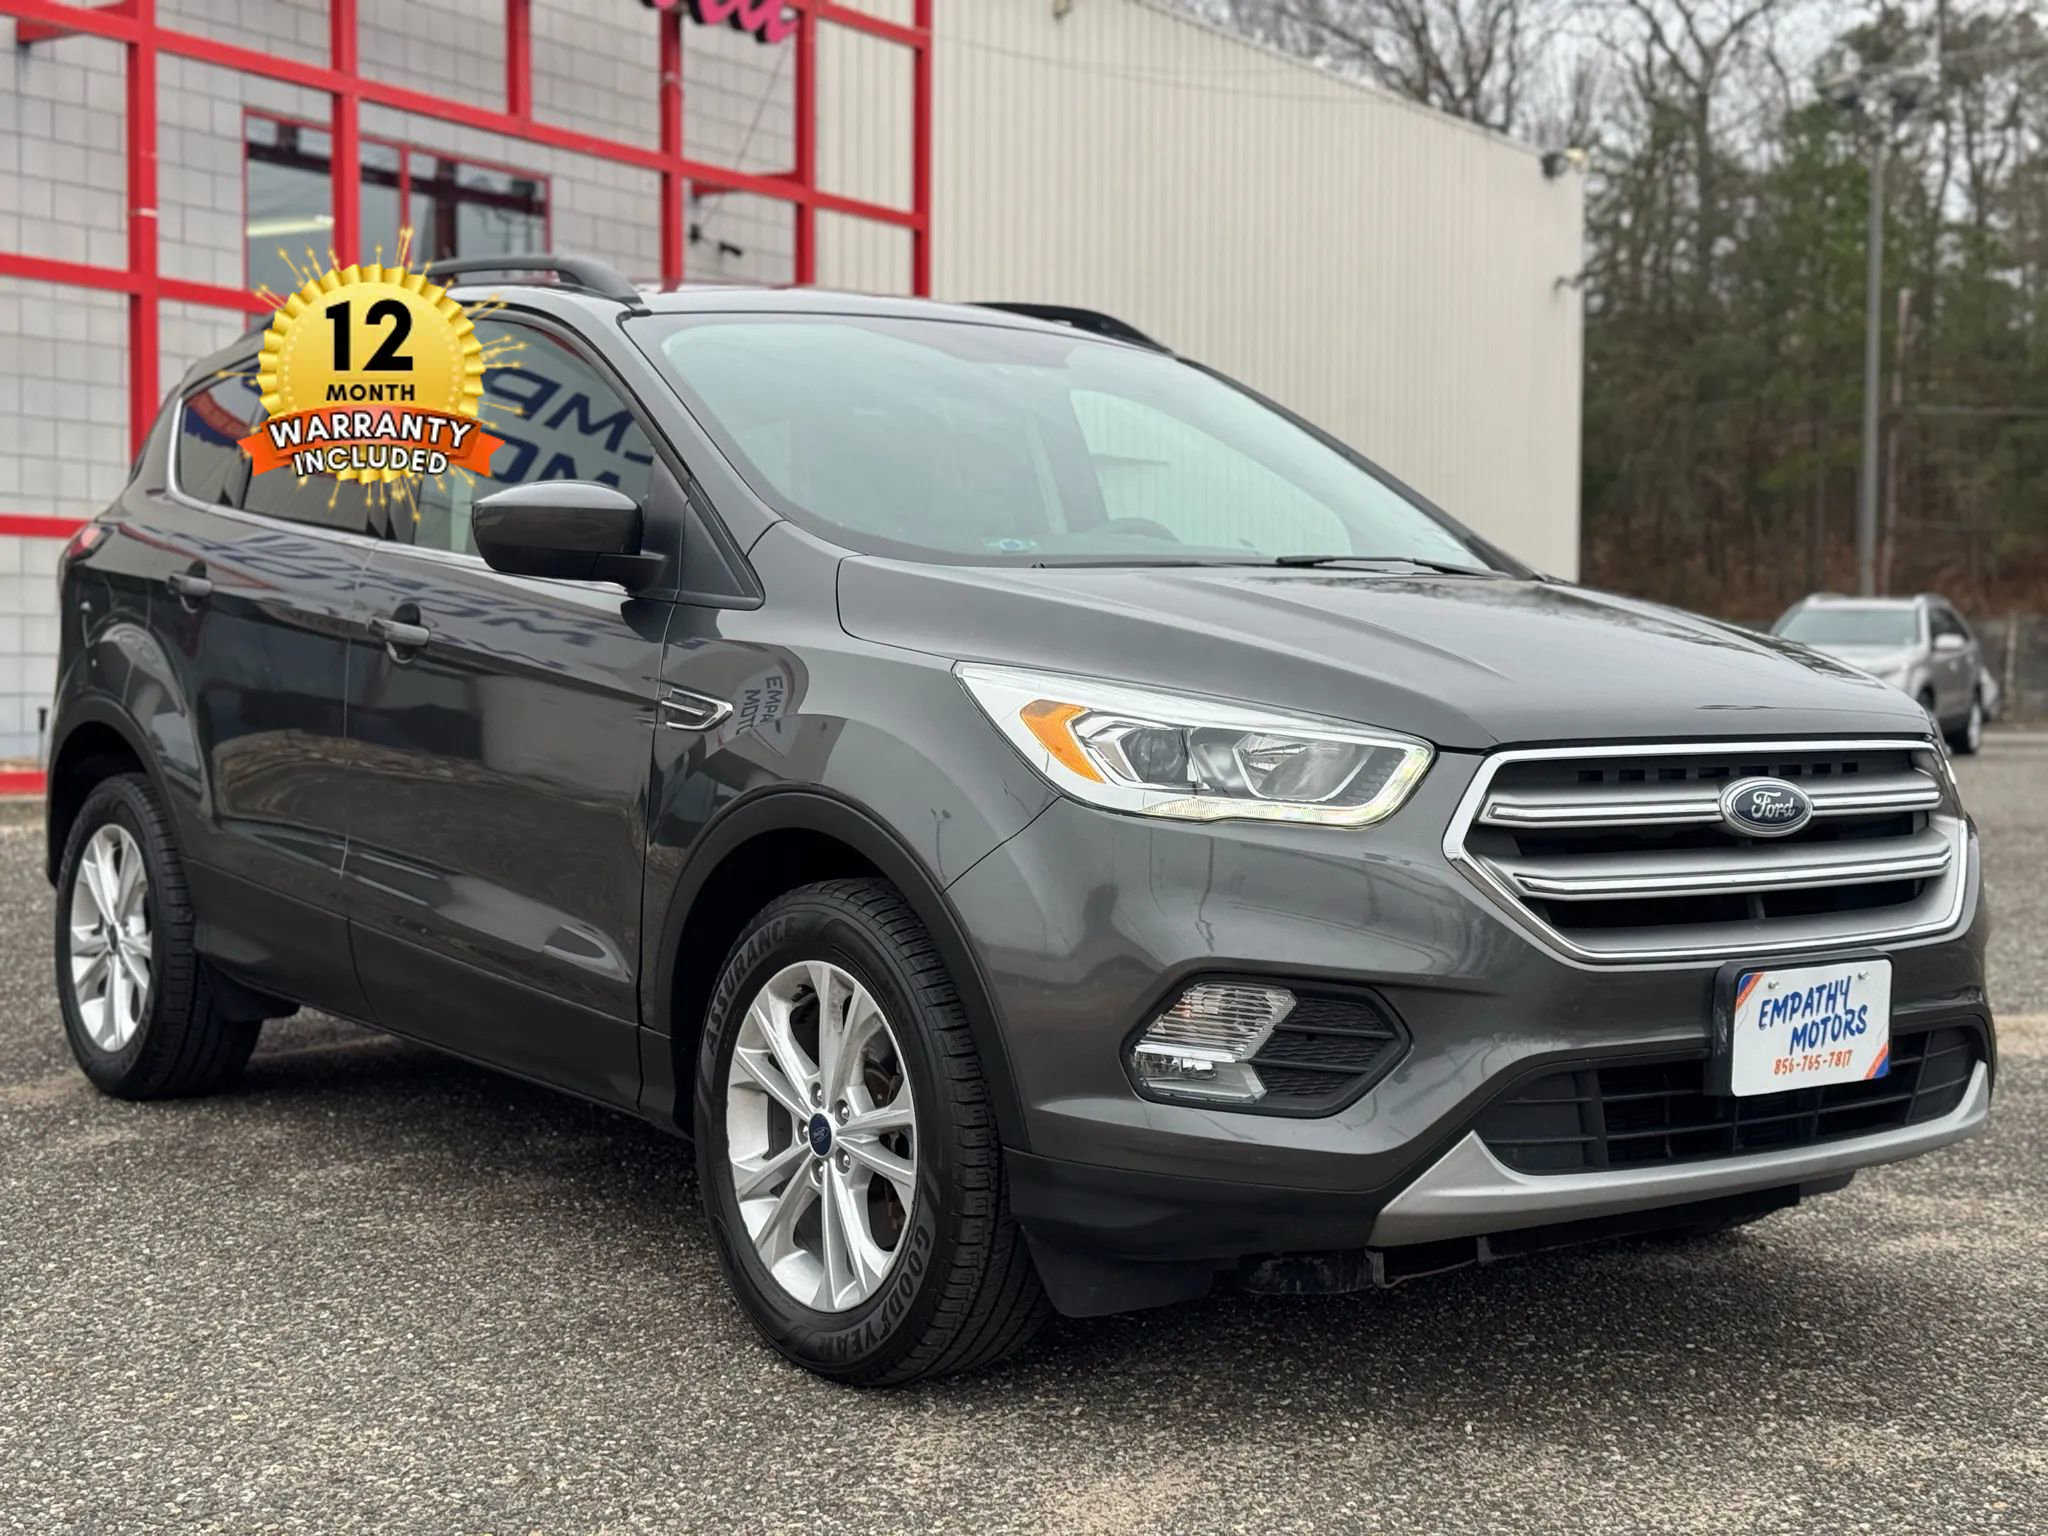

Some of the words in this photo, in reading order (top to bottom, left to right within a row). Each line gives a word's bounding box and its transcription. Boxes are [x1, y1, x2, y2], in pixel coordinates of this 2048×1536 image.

[1751, 790, 1796, 819] Ford
[705, 916, 797, 1057] ASSURANCE
[1758, 975, 1852, 1031] EMPATHY
[1789, 1003, 1868, 1056] MOTORS
[1773, 1049, 1853, 1076] 856-765-7817
